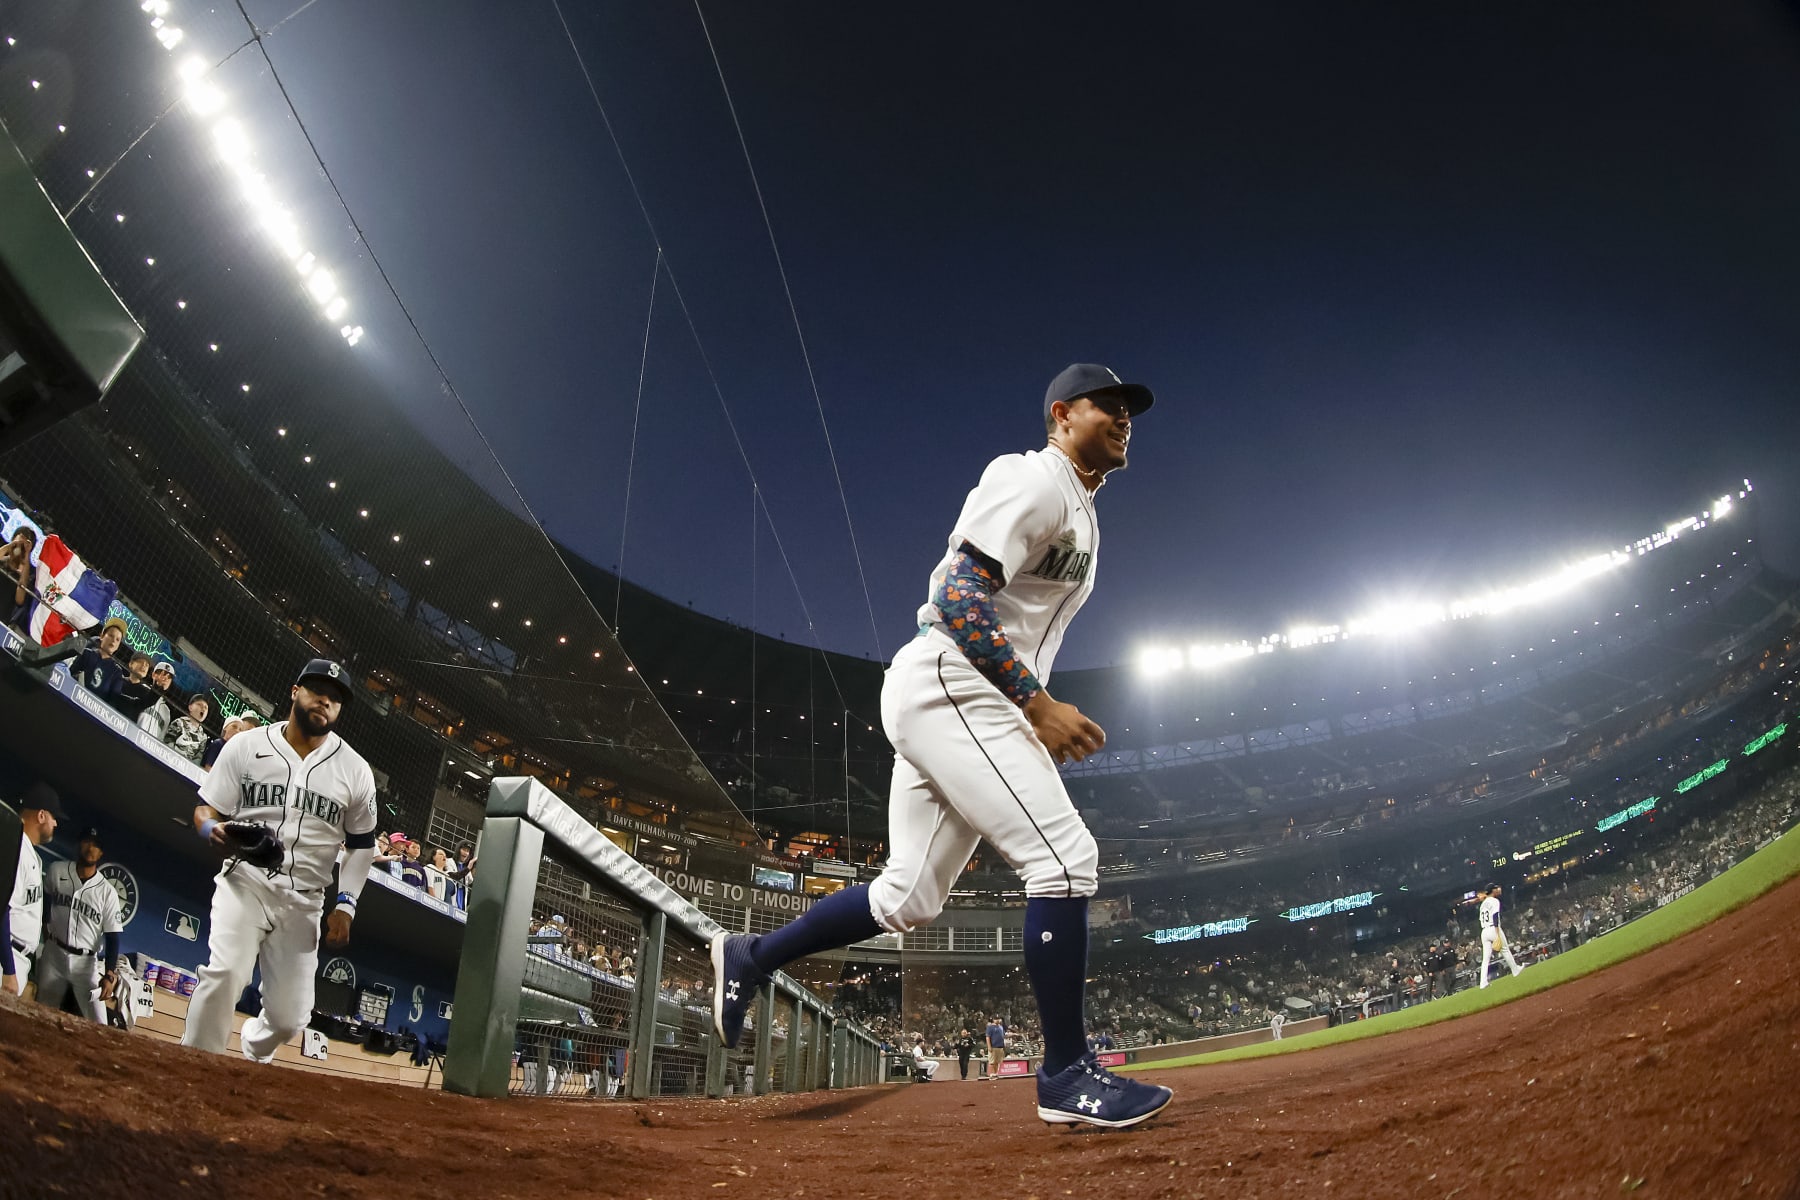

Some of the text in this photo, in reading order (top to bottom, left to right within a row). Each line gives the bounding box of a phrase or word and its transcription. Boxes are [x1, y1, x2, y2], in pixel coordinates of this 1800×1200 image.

[76, 689, 126, 732] MARINERS.COM
[613, 814, 632, 828] DAVE
[634, 821, 666, 838] NIEHAUS
[1492, 856, 1507, 868] 7:10
[641, 863, 715, 897] ELCOME
[721, 882, 744, 901] TO
[751, 888, 812, 913] T-MOBIL
[1657, 883, 1695, 907] ROOT SPORTS
[1290, 891, 1374, 922] ELECTRIC FACTORY
[1155, 917, 1248, 944] ELECTRIC FACTORY
[408, 985, 425, 1023] S
